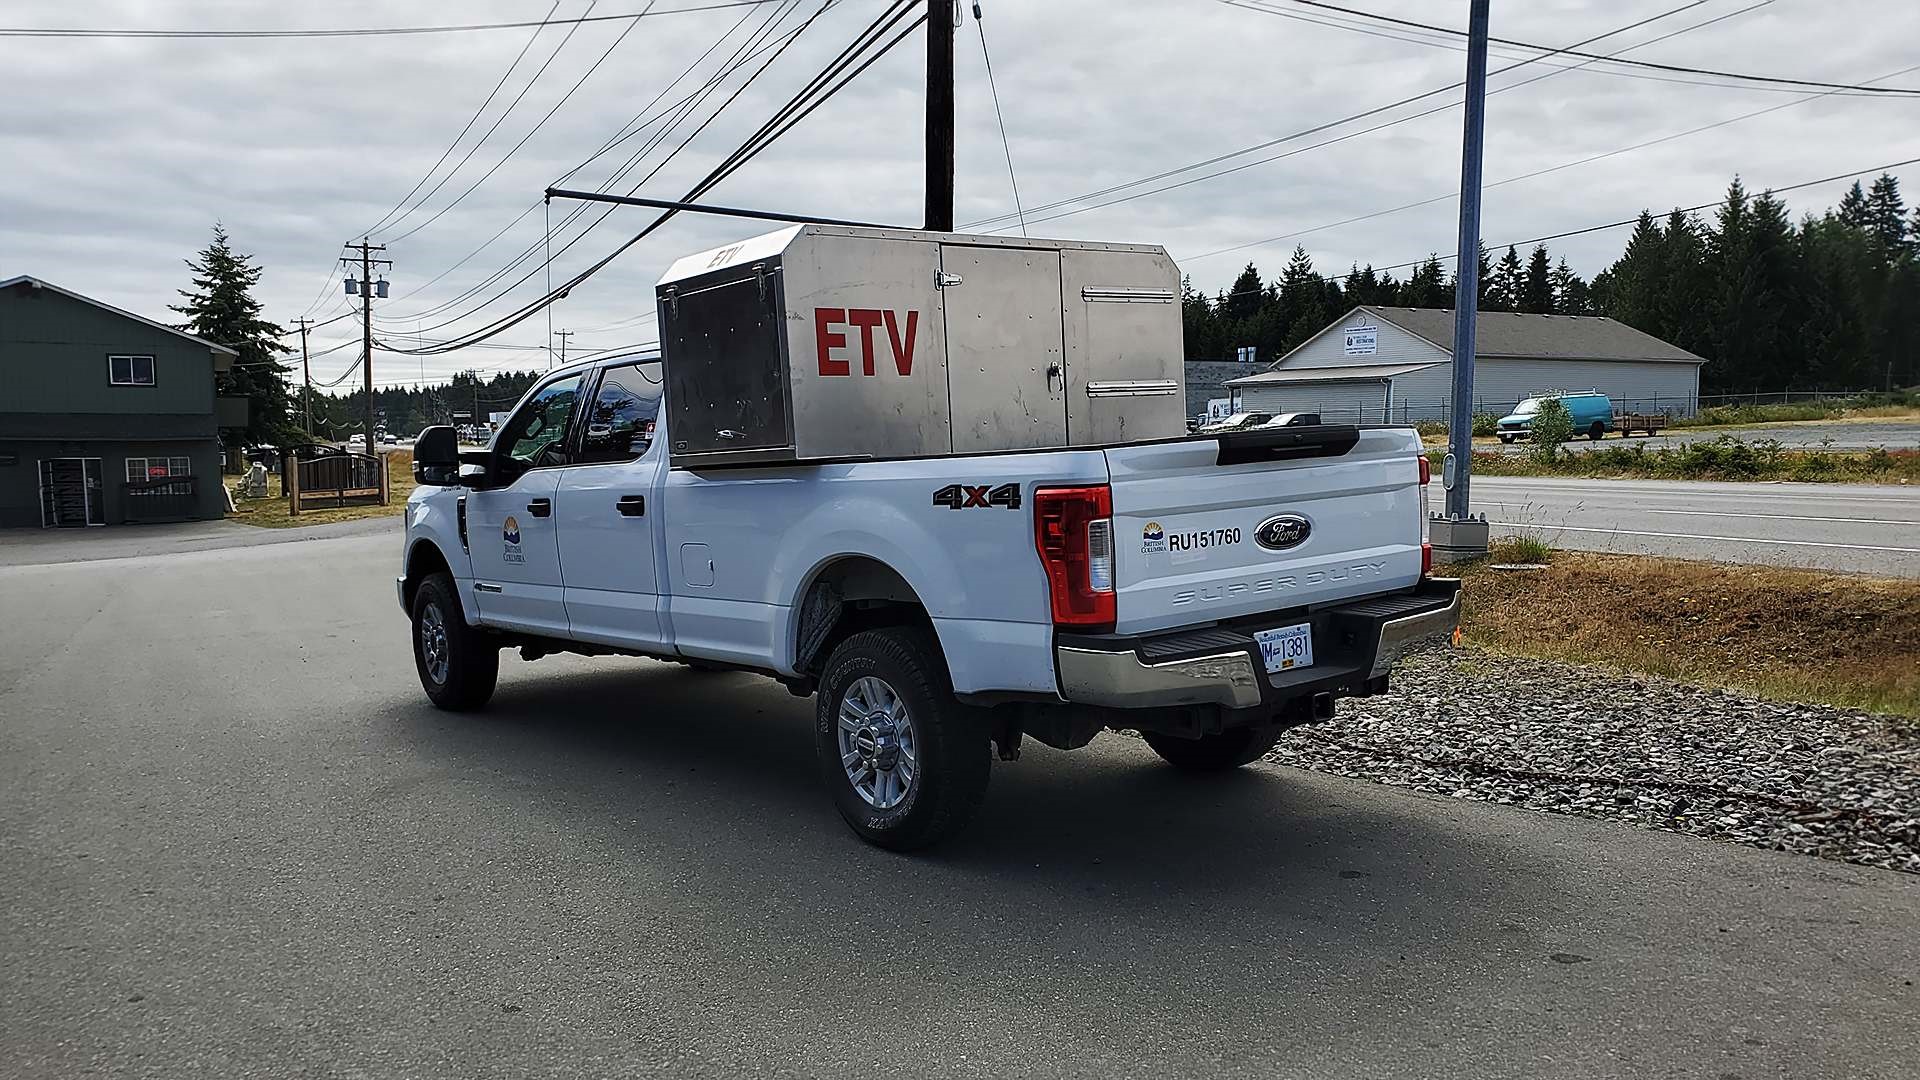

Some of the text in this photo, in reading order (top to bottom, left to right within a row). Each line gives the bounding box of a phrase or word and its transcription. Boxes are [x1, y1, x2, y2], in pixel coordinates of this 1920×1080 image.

[707, 245, 745, 268] ETV
[814, 307, 919, 377] ETV
[1168, 527, 1241, 552] RU151760
[1270, 521, 1301, 542] Ford
[1172, 560, 1386, 606] SUPER DUTY
